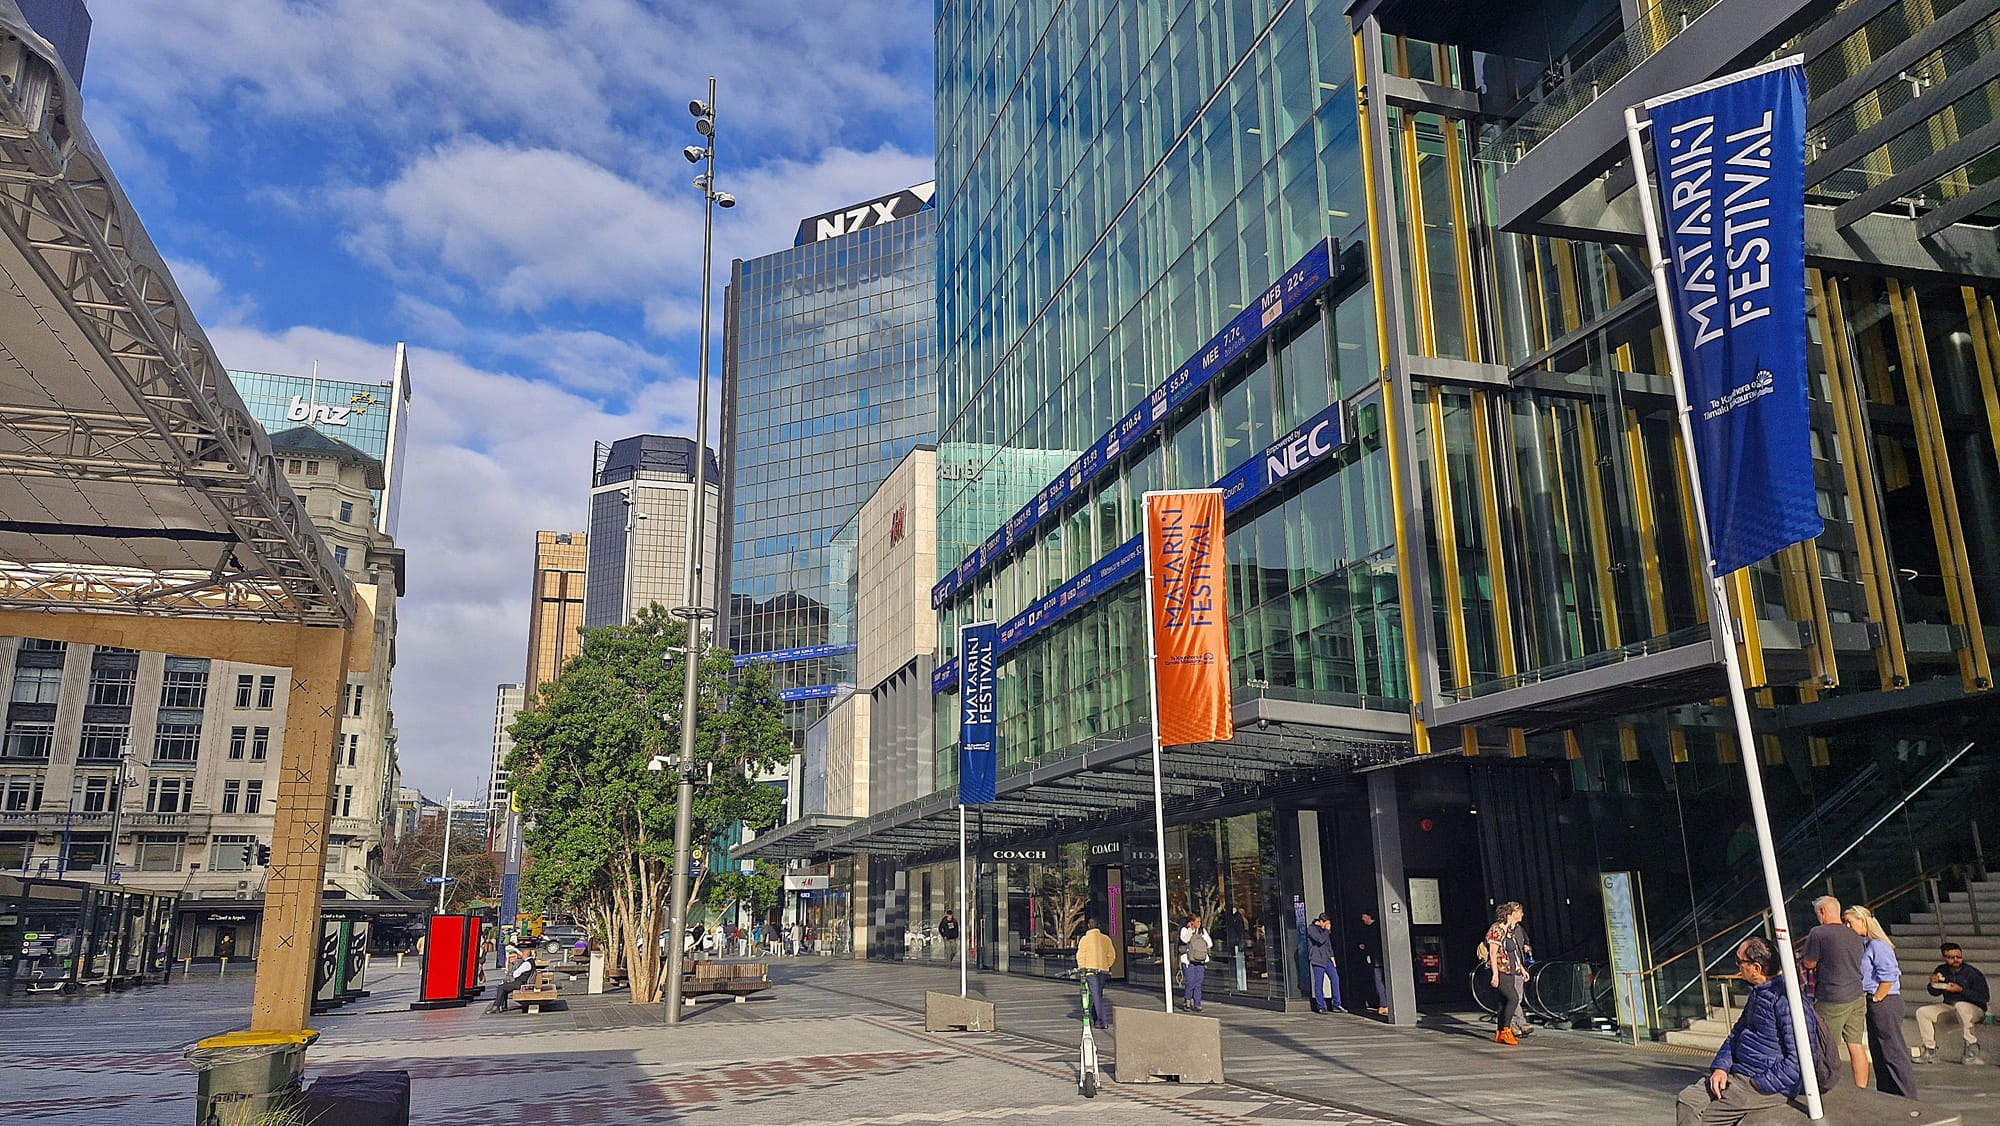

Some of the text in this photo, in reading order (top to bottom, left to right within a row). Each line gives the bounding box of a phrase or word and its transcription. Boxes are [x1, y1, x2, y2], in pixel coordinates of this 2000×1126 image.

[816, 196, 901, 242] NZX
[1670, 113, 1725, 350] MATARIKI
[1724, 110, 1773, 328] FESTIVAL
[1261, 284, 1281, 310] MFB
[1202, 345, 1219, 370] MEE
[1151, 384, 1167, 406] MDZ
[1170, 368, 1189, 393] $5.59
[287, 395, 352, 426] bnz
[1108, 428, 1117, 443] IFT
[1122, 410, 1142, 435] $10.54
[1266, 431, 1294, 457] Empowered
[1266, 419, 1331, 485] NEC
[1069, 460, 1081, 477] GMT
[1161, 509, 1184, 628] MATARIKI
[1190, 516, 1213, 626] FESTIVAL
[964, 637, 979, 725] MATARIKI
[980, 641, 992, 724] FESTIVAL
[993, 850, 1047, 859] COACH
[1092, 841, 1120, 855] COACH
[1604, 876, 1614, 889] G
